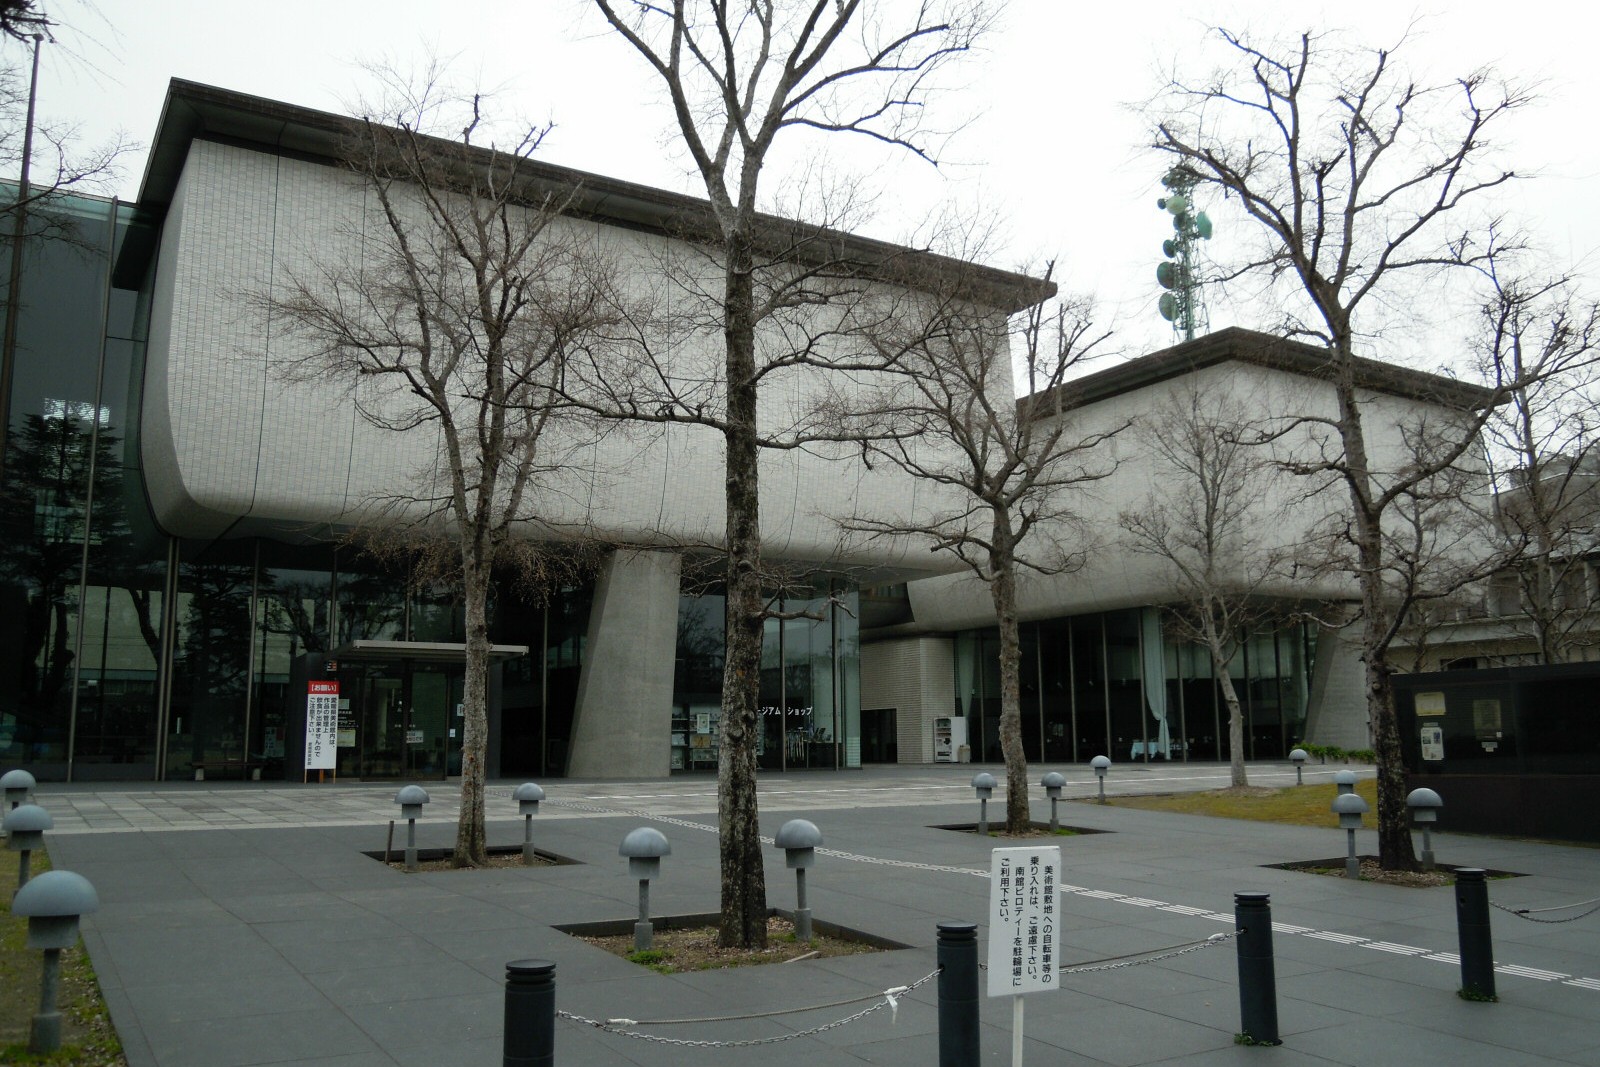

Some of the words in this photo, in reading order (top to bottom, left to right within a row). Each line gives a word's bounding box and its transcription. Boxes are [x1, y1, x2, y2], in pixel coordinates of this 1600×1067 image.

[788, 706, 812, 716] ショップ
[999, 857, 1010, 923] ご利用下さい。
[1012, 866, 1025, 987] 南館ピロティーを駐輪場に
[1041, 865, 1053, 983] 美術館敷地への自転車等の
